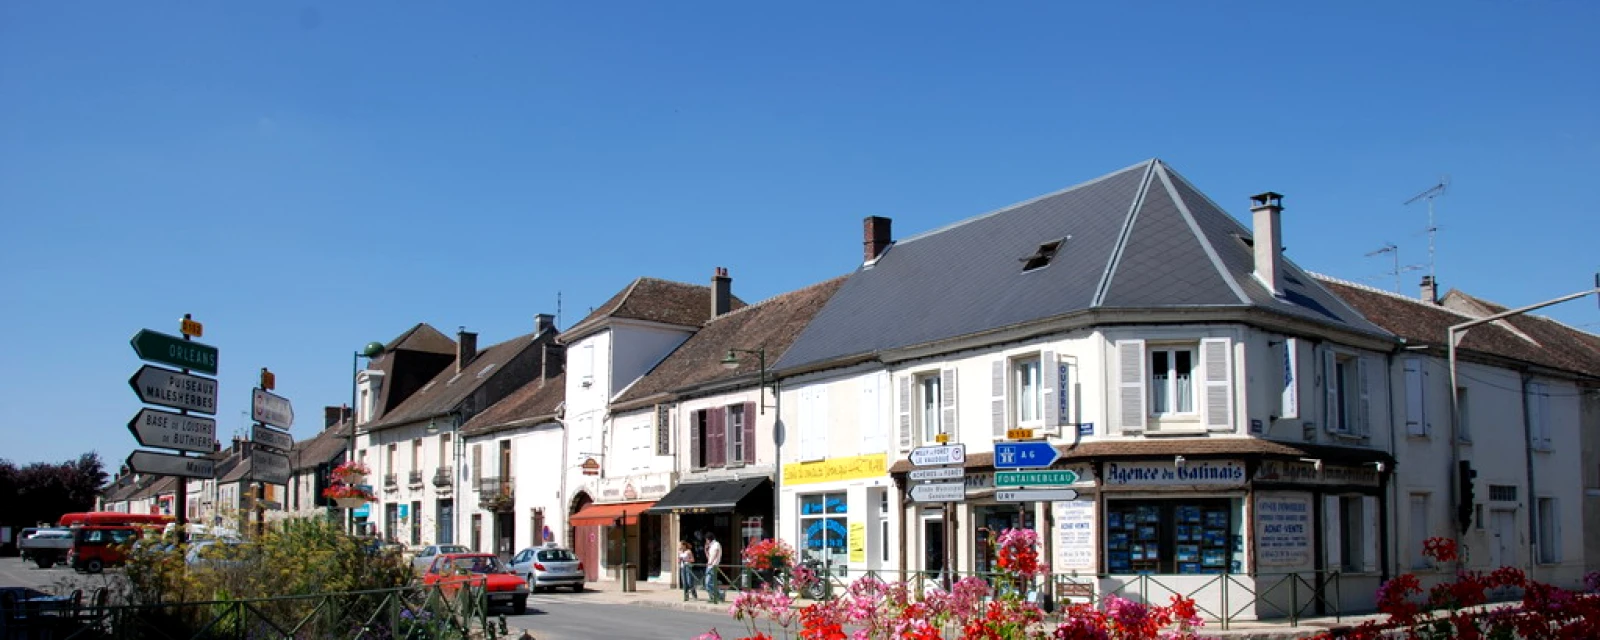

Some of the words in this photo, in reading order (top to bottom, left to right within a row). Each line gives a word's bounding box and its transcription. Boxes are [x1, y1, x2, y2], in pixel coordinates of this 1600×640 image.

[169, 376, 214, 396] PUISEAUX
[146, 386, 214, 409] MALESHERBES
[146, 415, 167, 430] BASE
[182, 419, 213, 435] LOISIRS
[173, 433, 213, 448] BUTHIERS
[1008, 430, 1032, 438] D152
[1021, 450, 1027, 459] A
[186, 461, 212, 475] Mairie
[1107, 463, 1159, 484] Agence
[1162, 467, 1175, 480] du
[997, 473, 1071, 483] FONTAINEBLEAU
